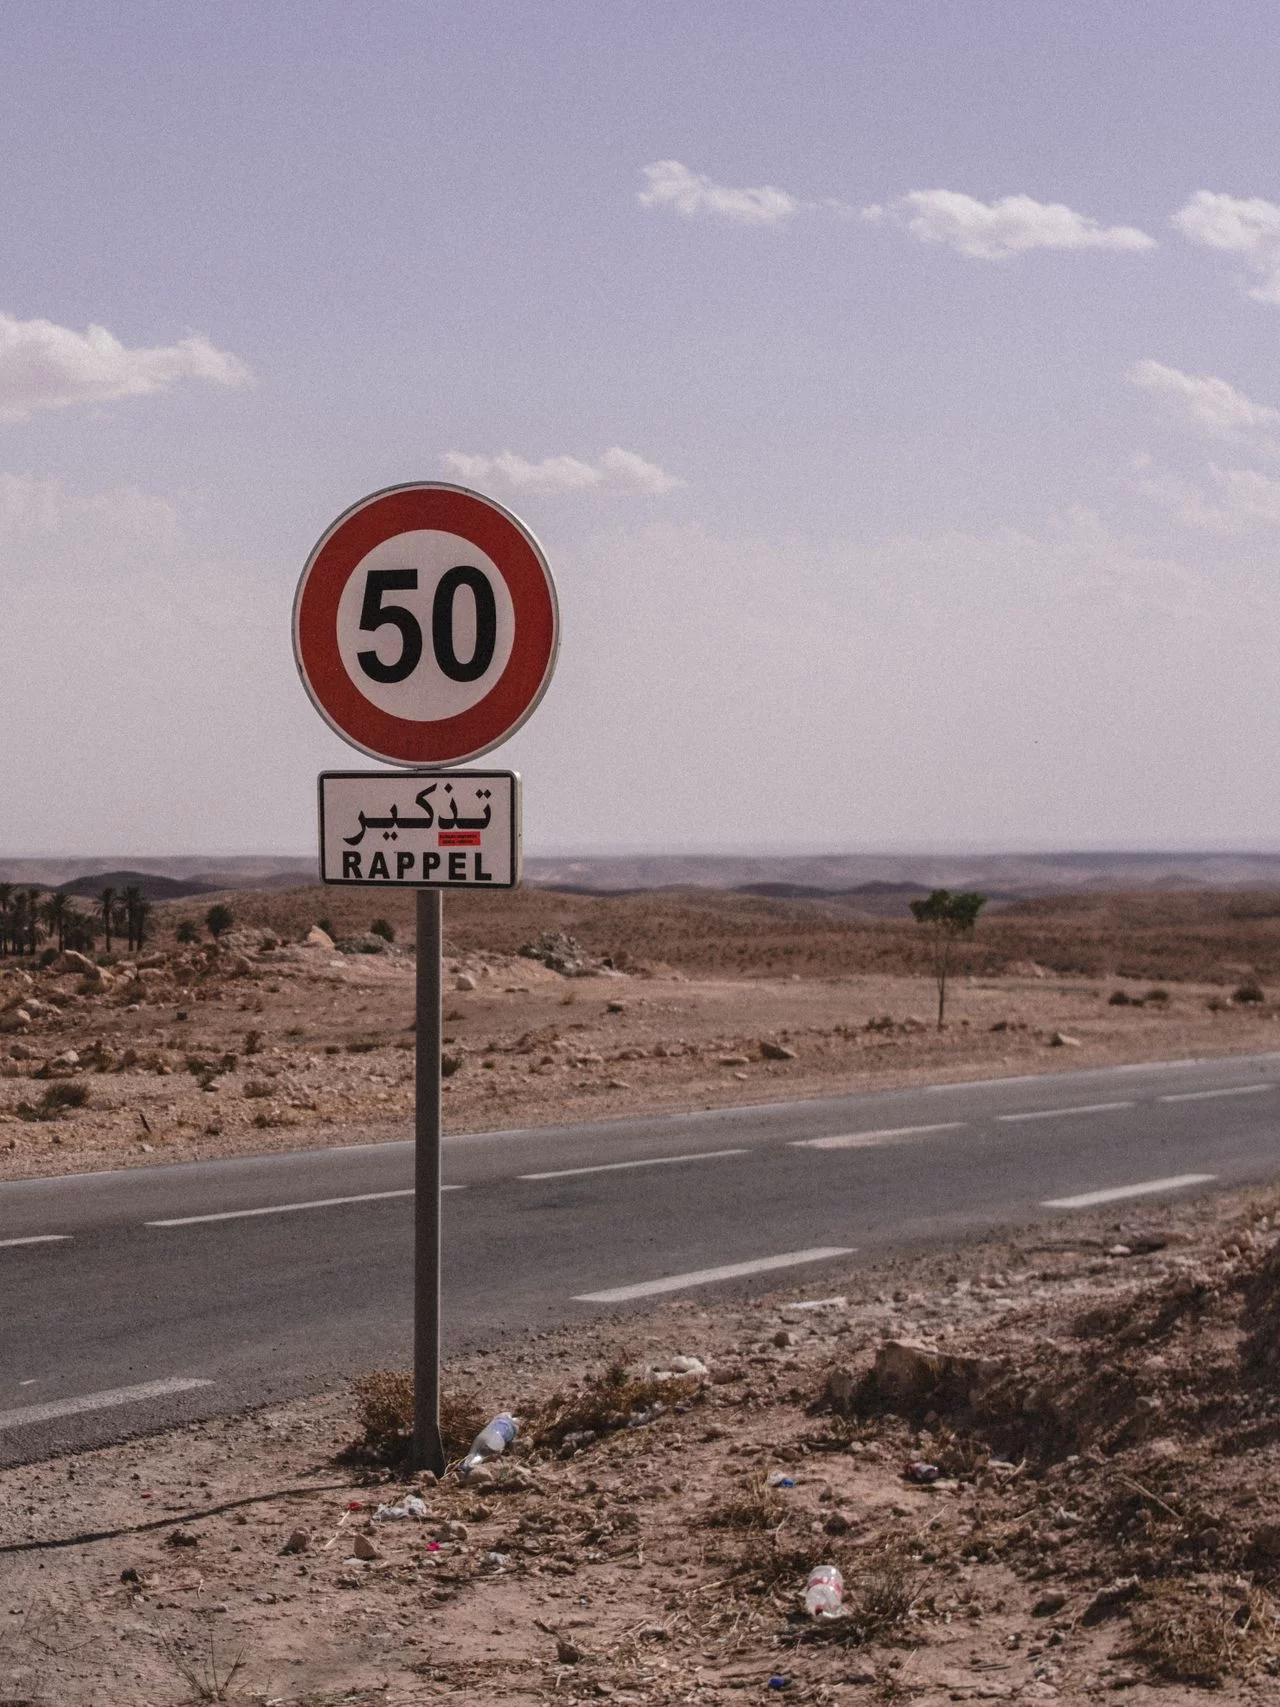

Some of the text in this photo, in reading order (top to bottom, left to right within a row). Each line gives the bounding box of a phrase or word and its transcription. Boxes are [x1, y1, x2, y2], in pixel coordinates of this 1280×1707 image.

[357, 565, 496, 683] 50
[342, 783, 492, 846] تذكير
[342, 851, 492, 881] RAPPEL
